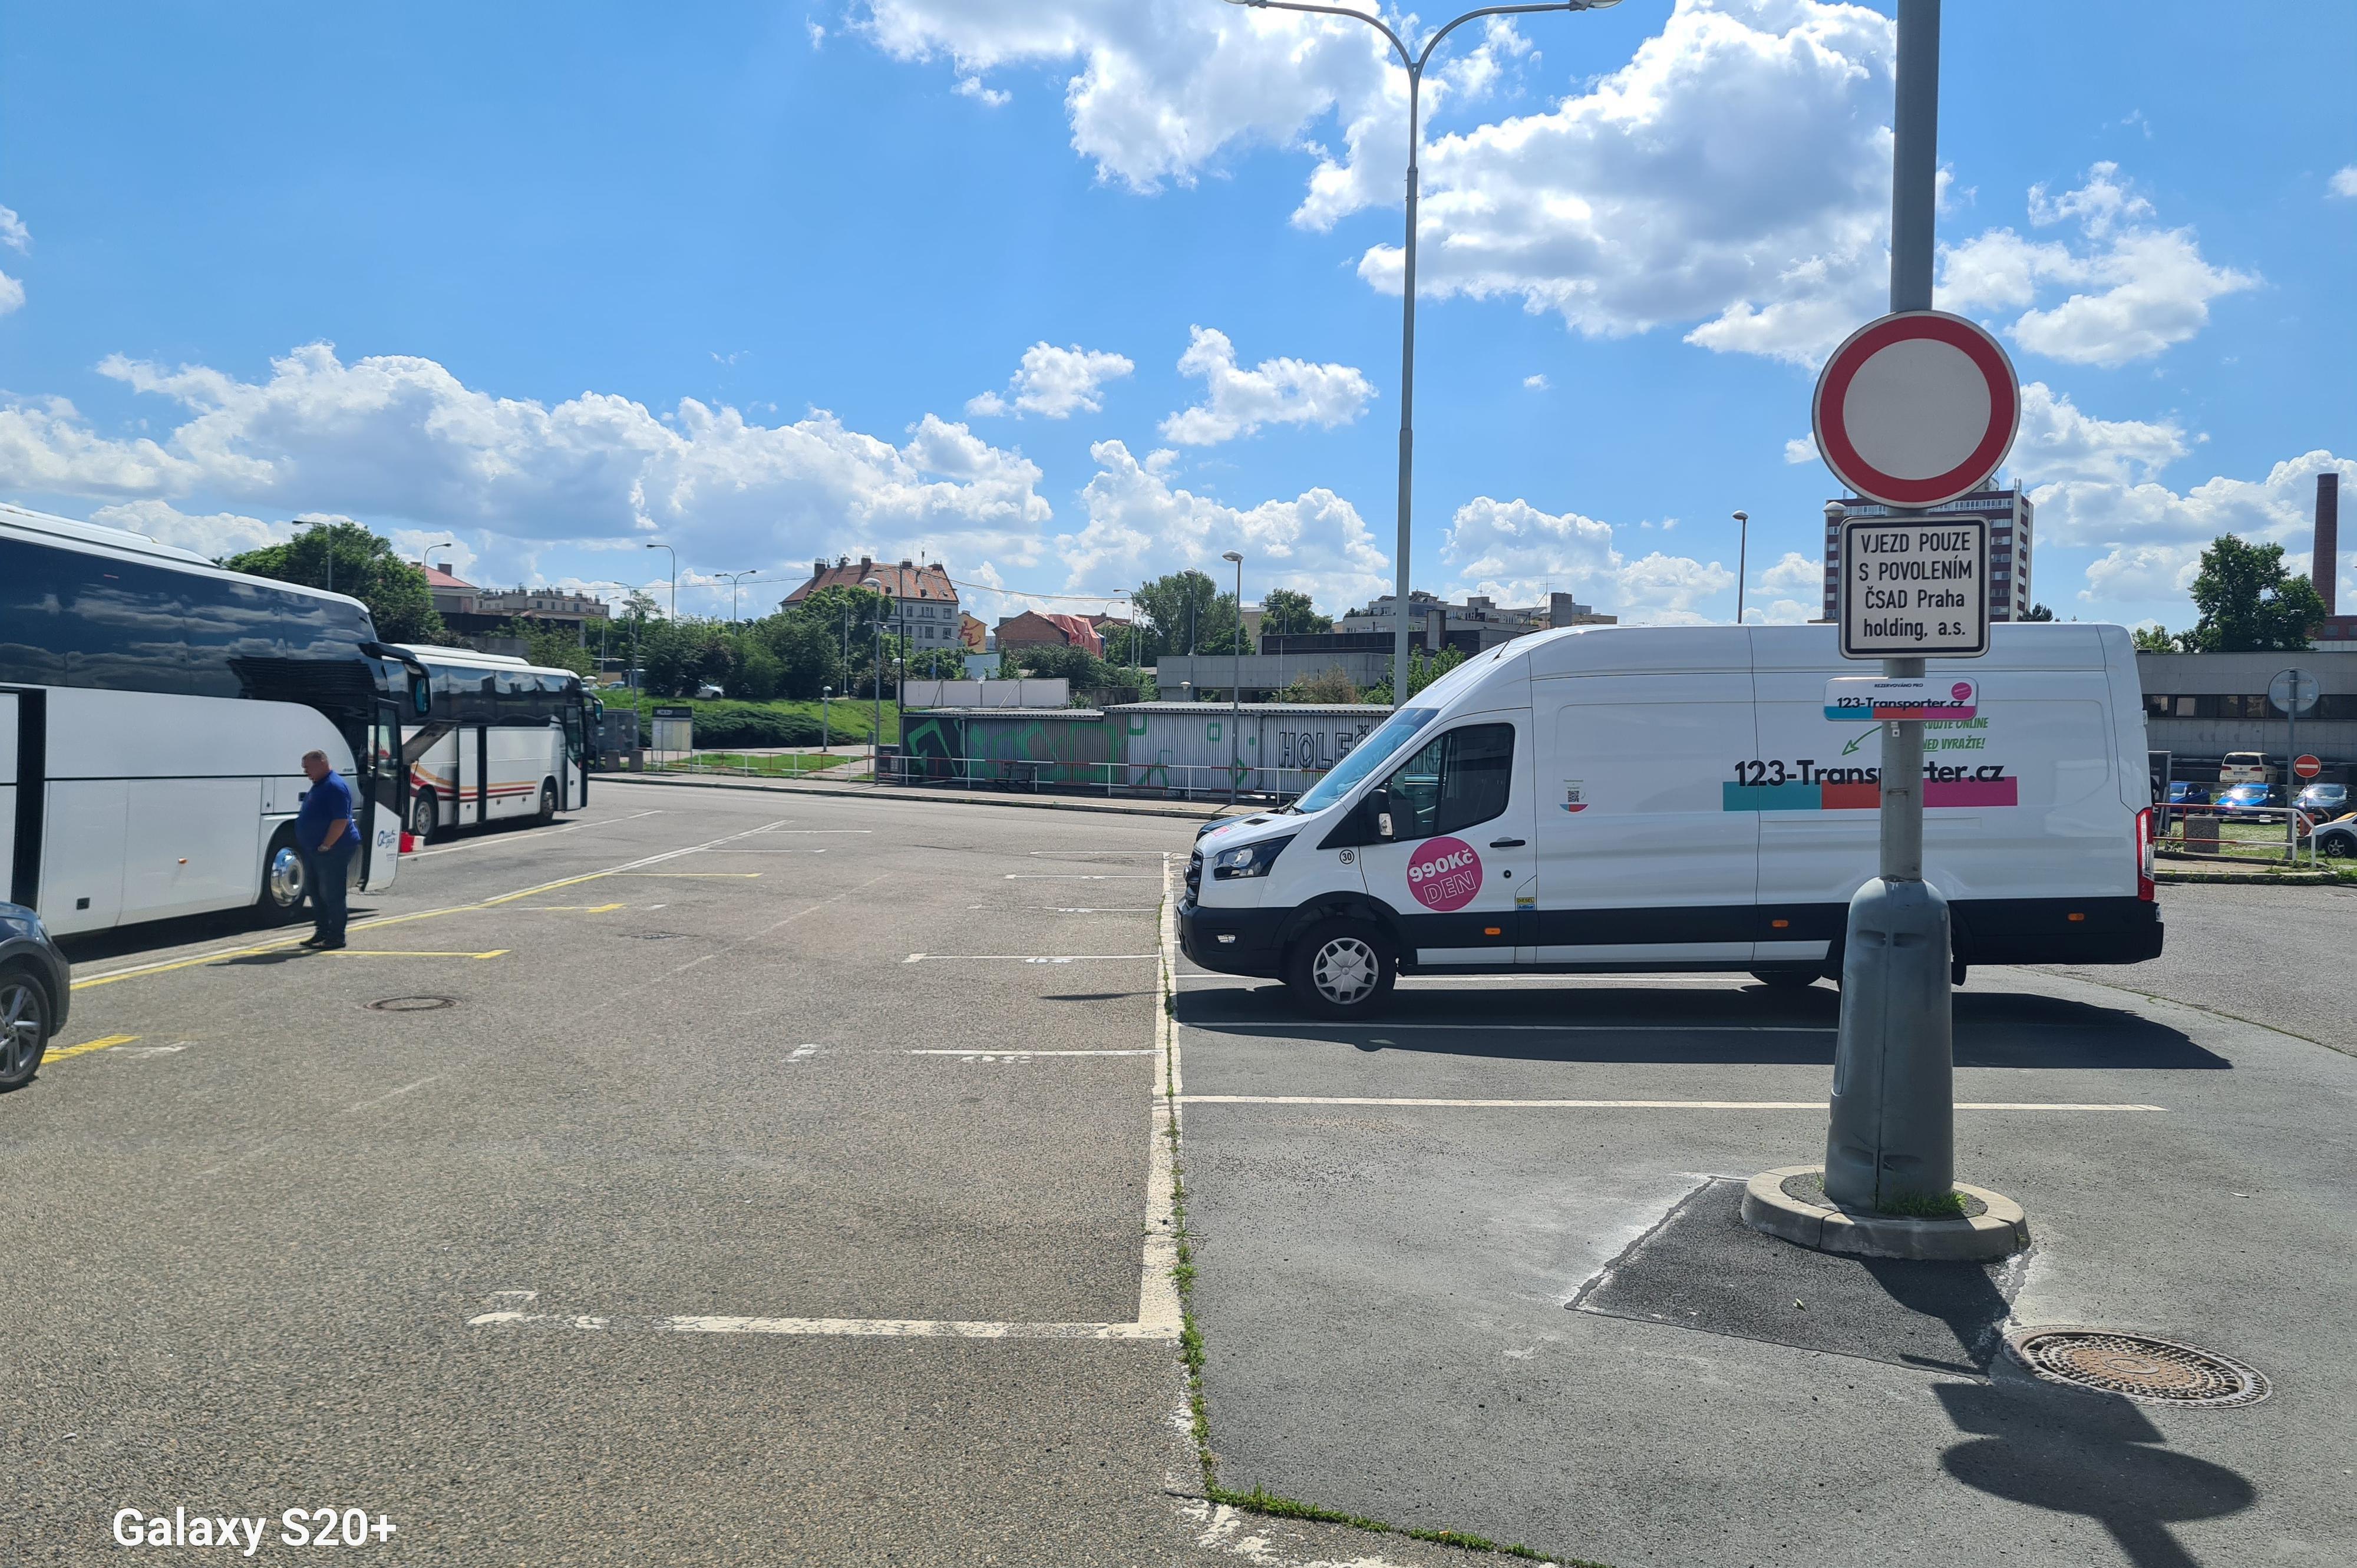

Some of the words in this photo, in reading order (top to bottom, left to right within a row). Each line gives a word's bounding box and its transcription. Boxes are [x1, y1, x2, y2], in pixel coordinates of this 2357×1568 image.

[1861, 533, 1910, 553] VJEZD
[1919, 532, 1971, 552] POUZE
[1858, 562, 1869, 581] S
[1879, 554, 1972, 581] POVOLENÍM
[1865, 585, 1907, 609] ČSAD
[1917, 589, 1965, 608] Praha
[1863, 618, 1928, 641] holding,
[1937, 621, 1966, 636] a.s.
[1836, 697, 1965, 711] 123-Transporter.cz
[1955, 717, 1989, 729] ONLINE
[1941, 734, 1986, 750] VYRAŽTE!
[1734, 759, 2005, 791] 123-Transter.cz
[1342, 852, 1352, 861] 30
[1408, 848, 1474, 882] 990Kč
[1423, 870, 1477, 905] DEN
